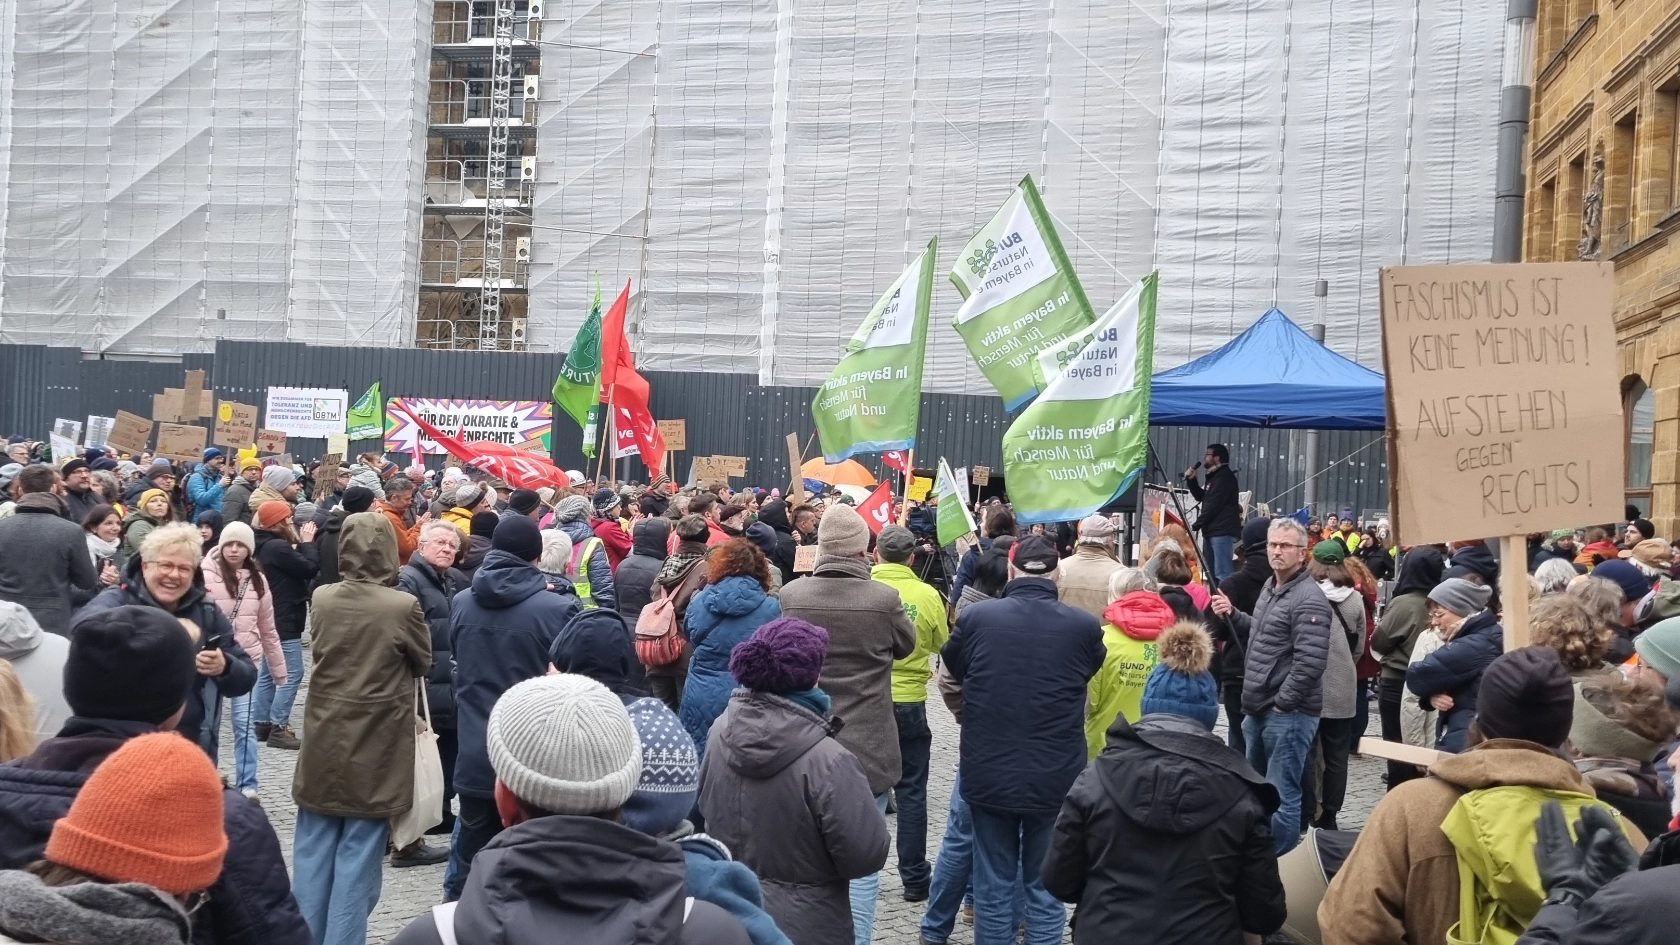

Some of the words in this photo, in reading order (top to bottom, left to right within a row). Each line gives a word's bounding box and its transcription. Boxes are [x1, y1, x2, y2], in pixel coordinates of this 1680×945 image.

[1394, 279, 1518, 322] FASCHISMUS
[1532, 278, 1563, 316] IST
[1409, 333, 1465, 373] KEINE
[1476, 324, 1590, 366] MEINUNG!
[510, 416, 518, 428] &
[1415, 390, 1568, 440] AUFSTEHEN
[1456, 442, 1513, 471] GEGEN
[1481, 460, 1592, 518] RECHTS!
[1119, 670, 1148, 679] Natursc
[1120, 662, 1144, 670] BUND
[1126, 680, 1144, 688] Bayer
